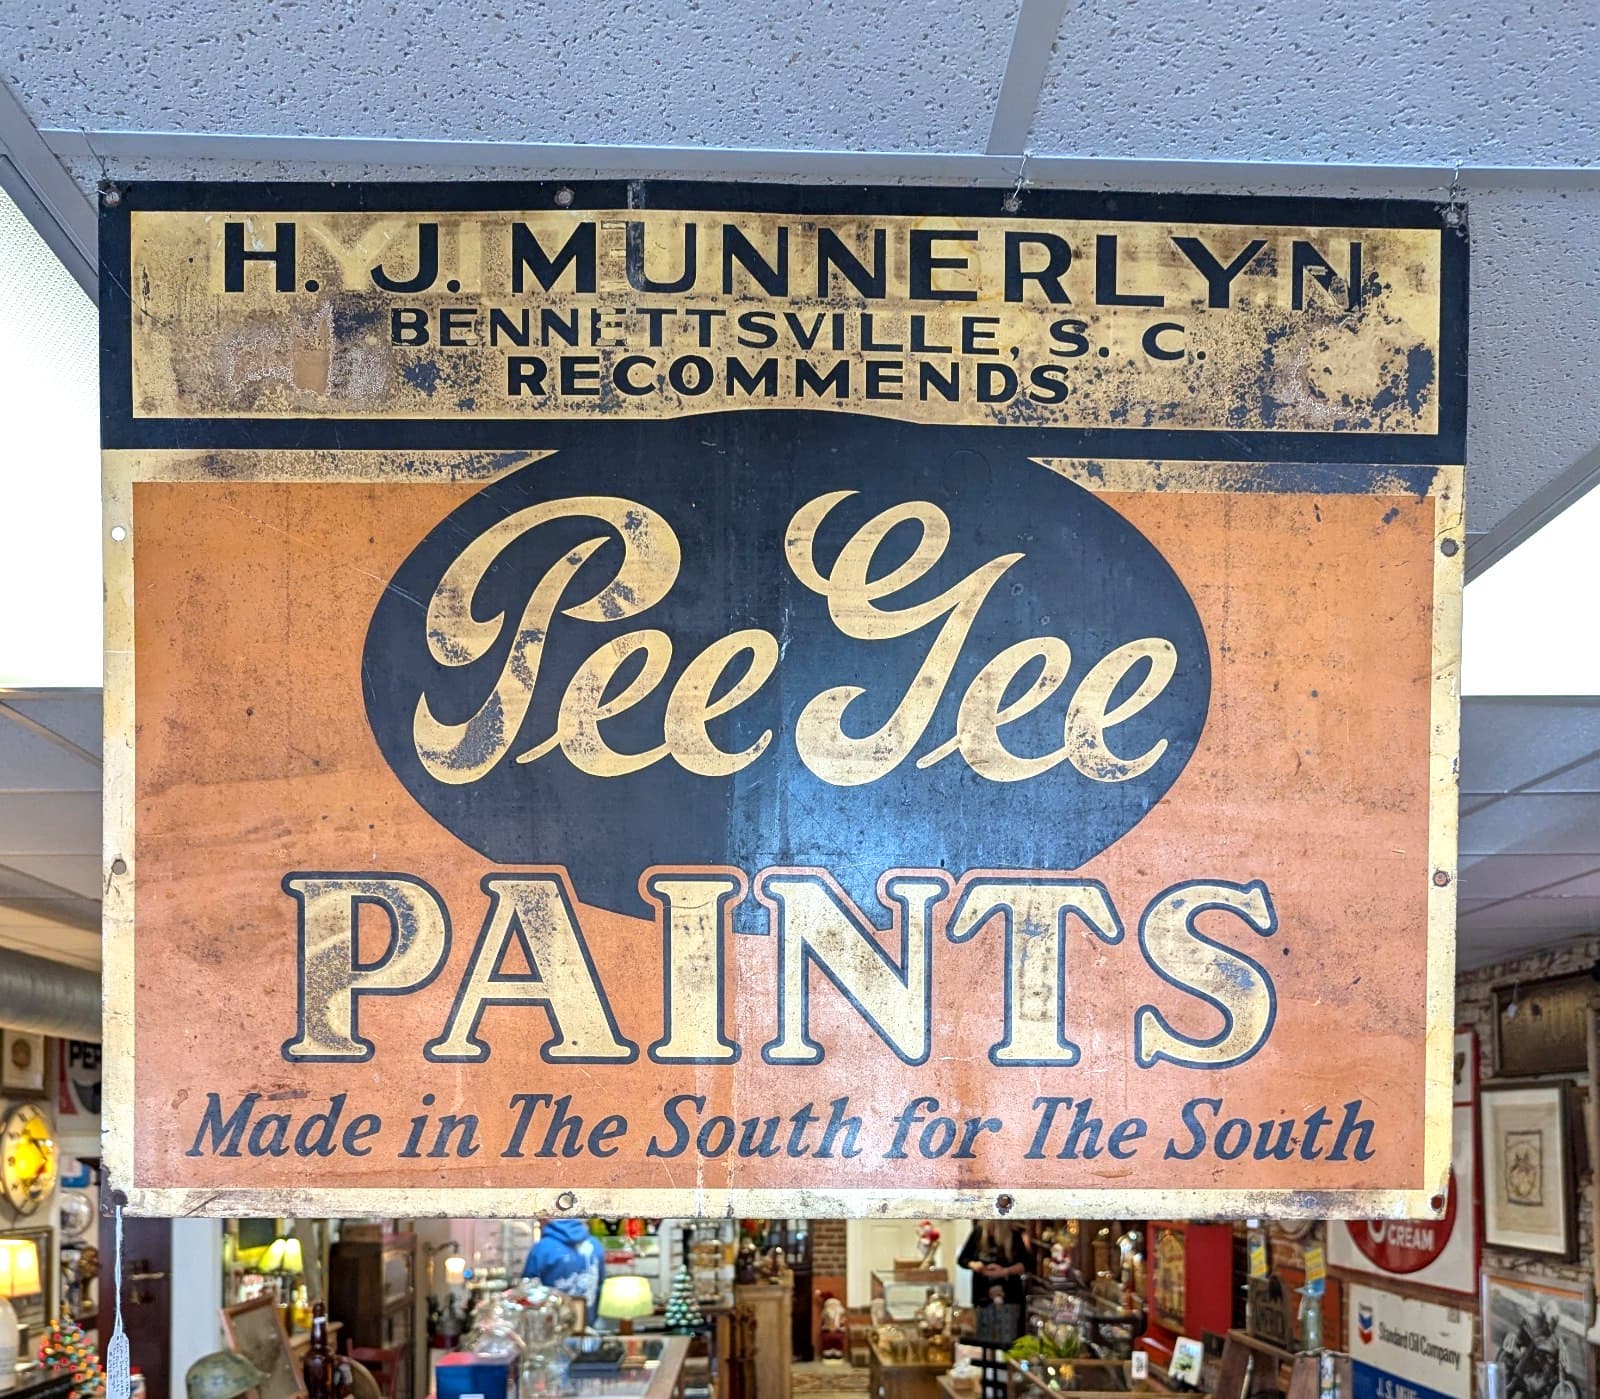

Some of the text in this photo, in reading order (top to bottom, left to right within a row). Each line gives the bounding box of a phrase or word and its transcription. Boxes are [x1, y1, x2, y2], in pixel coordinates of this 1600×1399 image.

[225, 222, 1364, 312] H. J. MUNNERLYN
[1049, 320, 1111, 358] S.
[1141, 322, 1207, 361] C.
[508, 355, 1070, 404] RECOMMENDS
[413, 489, 1178, 786] Pee Gee
[281, 871, 1279, 1069] PAINTS
[185, 1092, 1376, 1162] Made in The South for The South
[1388, 1224, 1435, 1251] CREAM
[1379, 1321, 1460, 1371] Standard Oil Company
